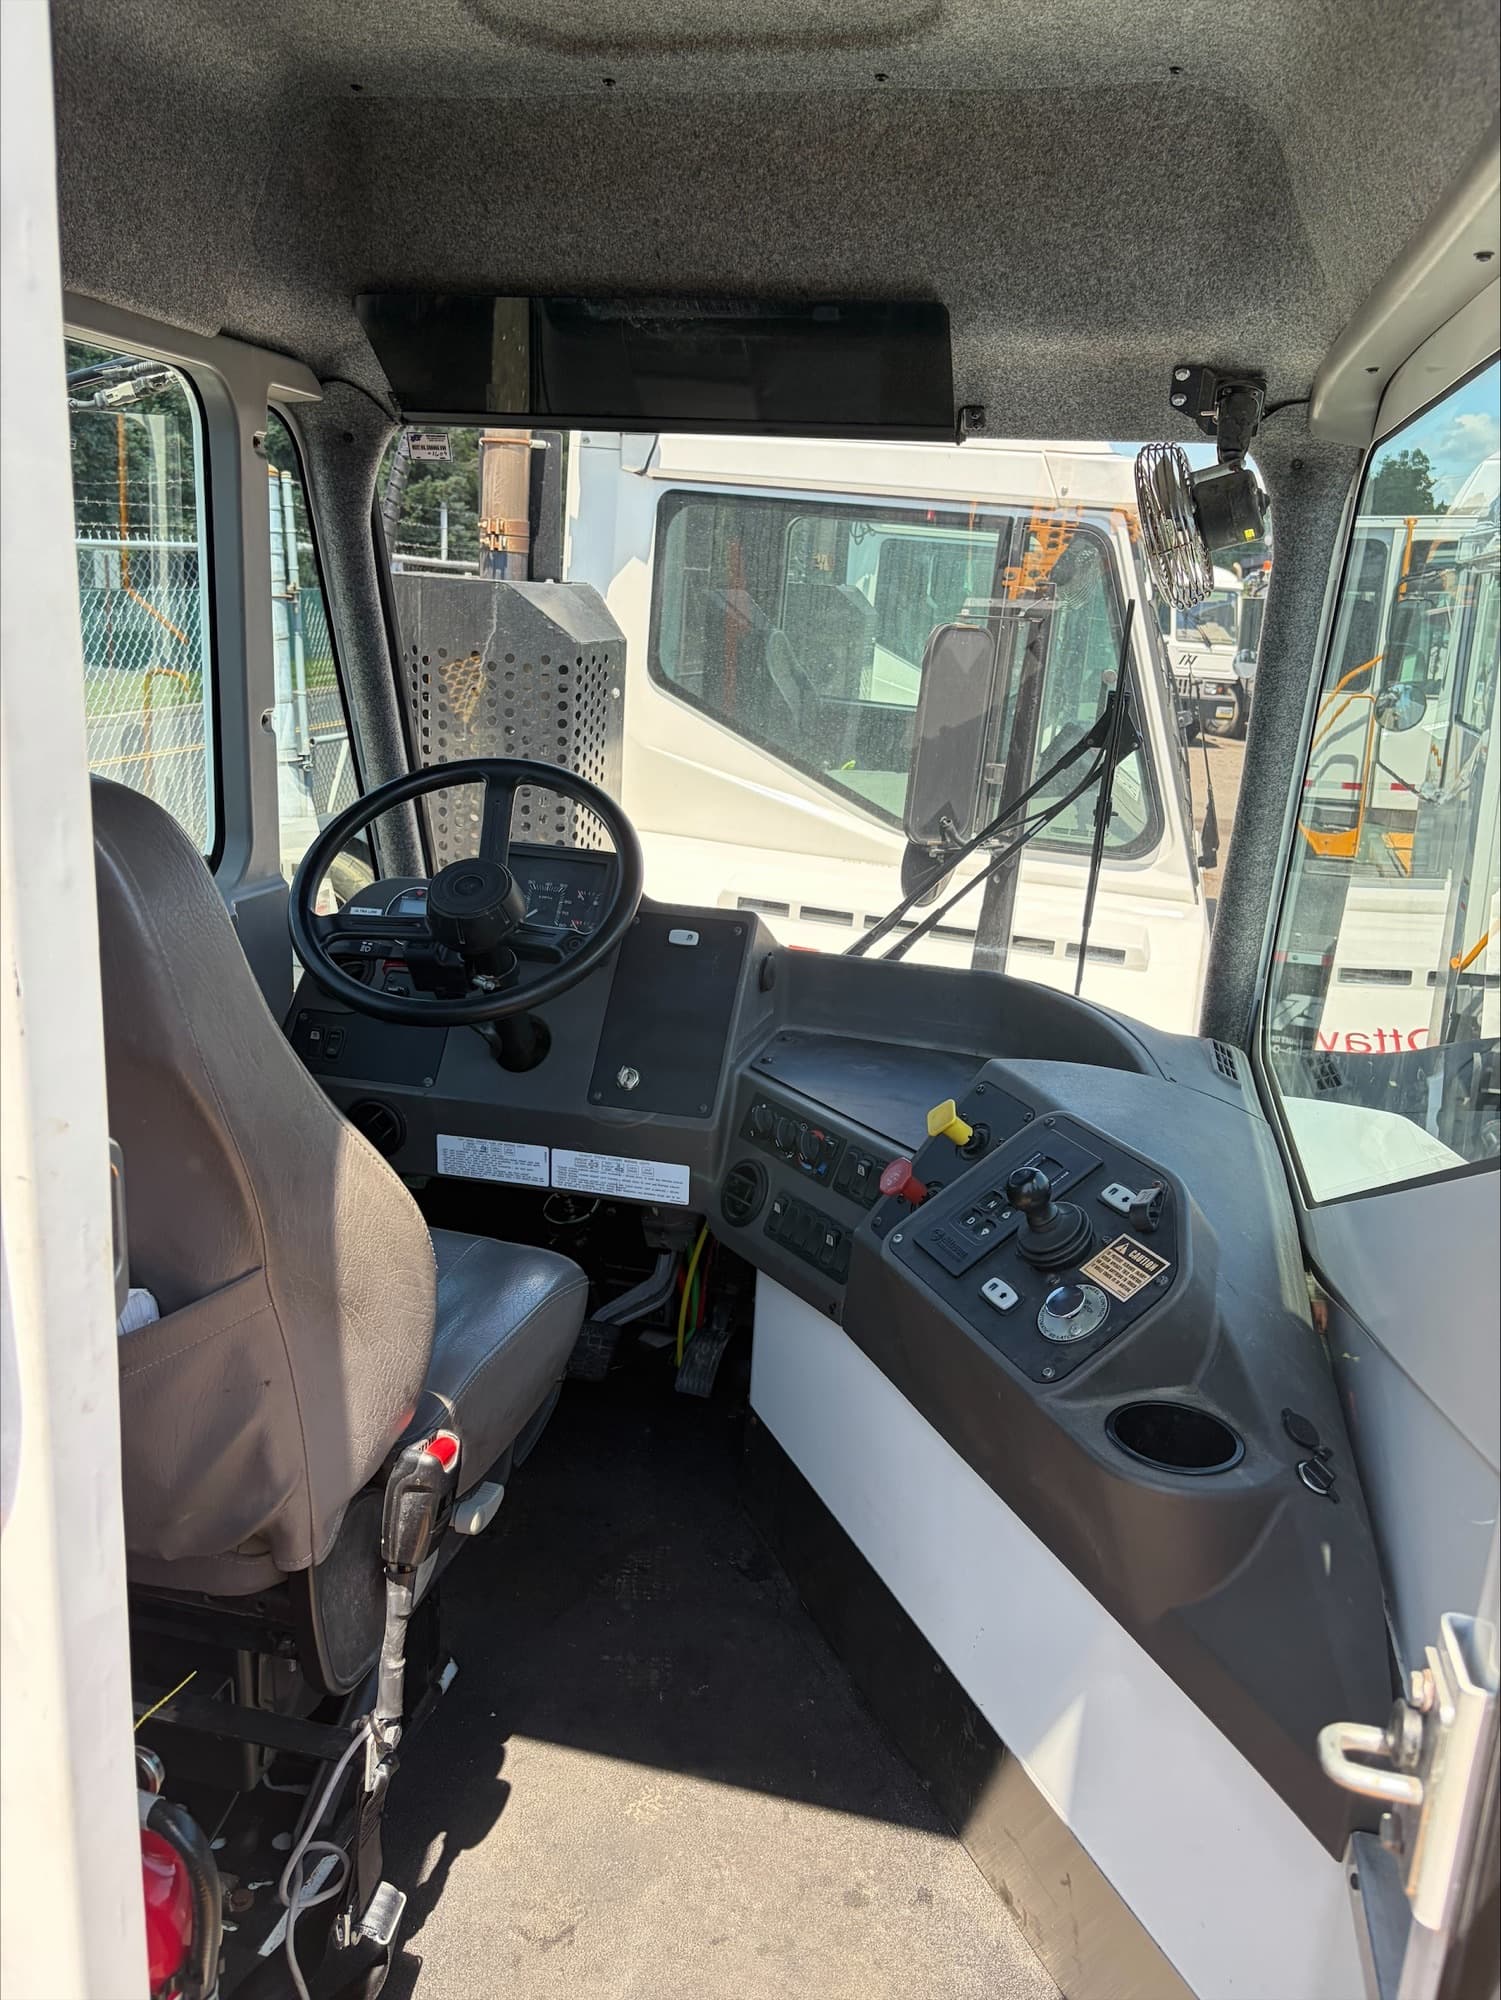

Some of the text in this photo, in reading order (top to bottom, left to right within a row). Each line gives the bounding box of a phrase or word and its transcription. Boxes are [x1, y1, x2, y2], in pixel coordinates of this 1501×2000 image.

[987, 1200, 998, 1209] N
[966, 1216, 976, 1225] D
[1128, 1249, 1160, 1272] CAUTION
